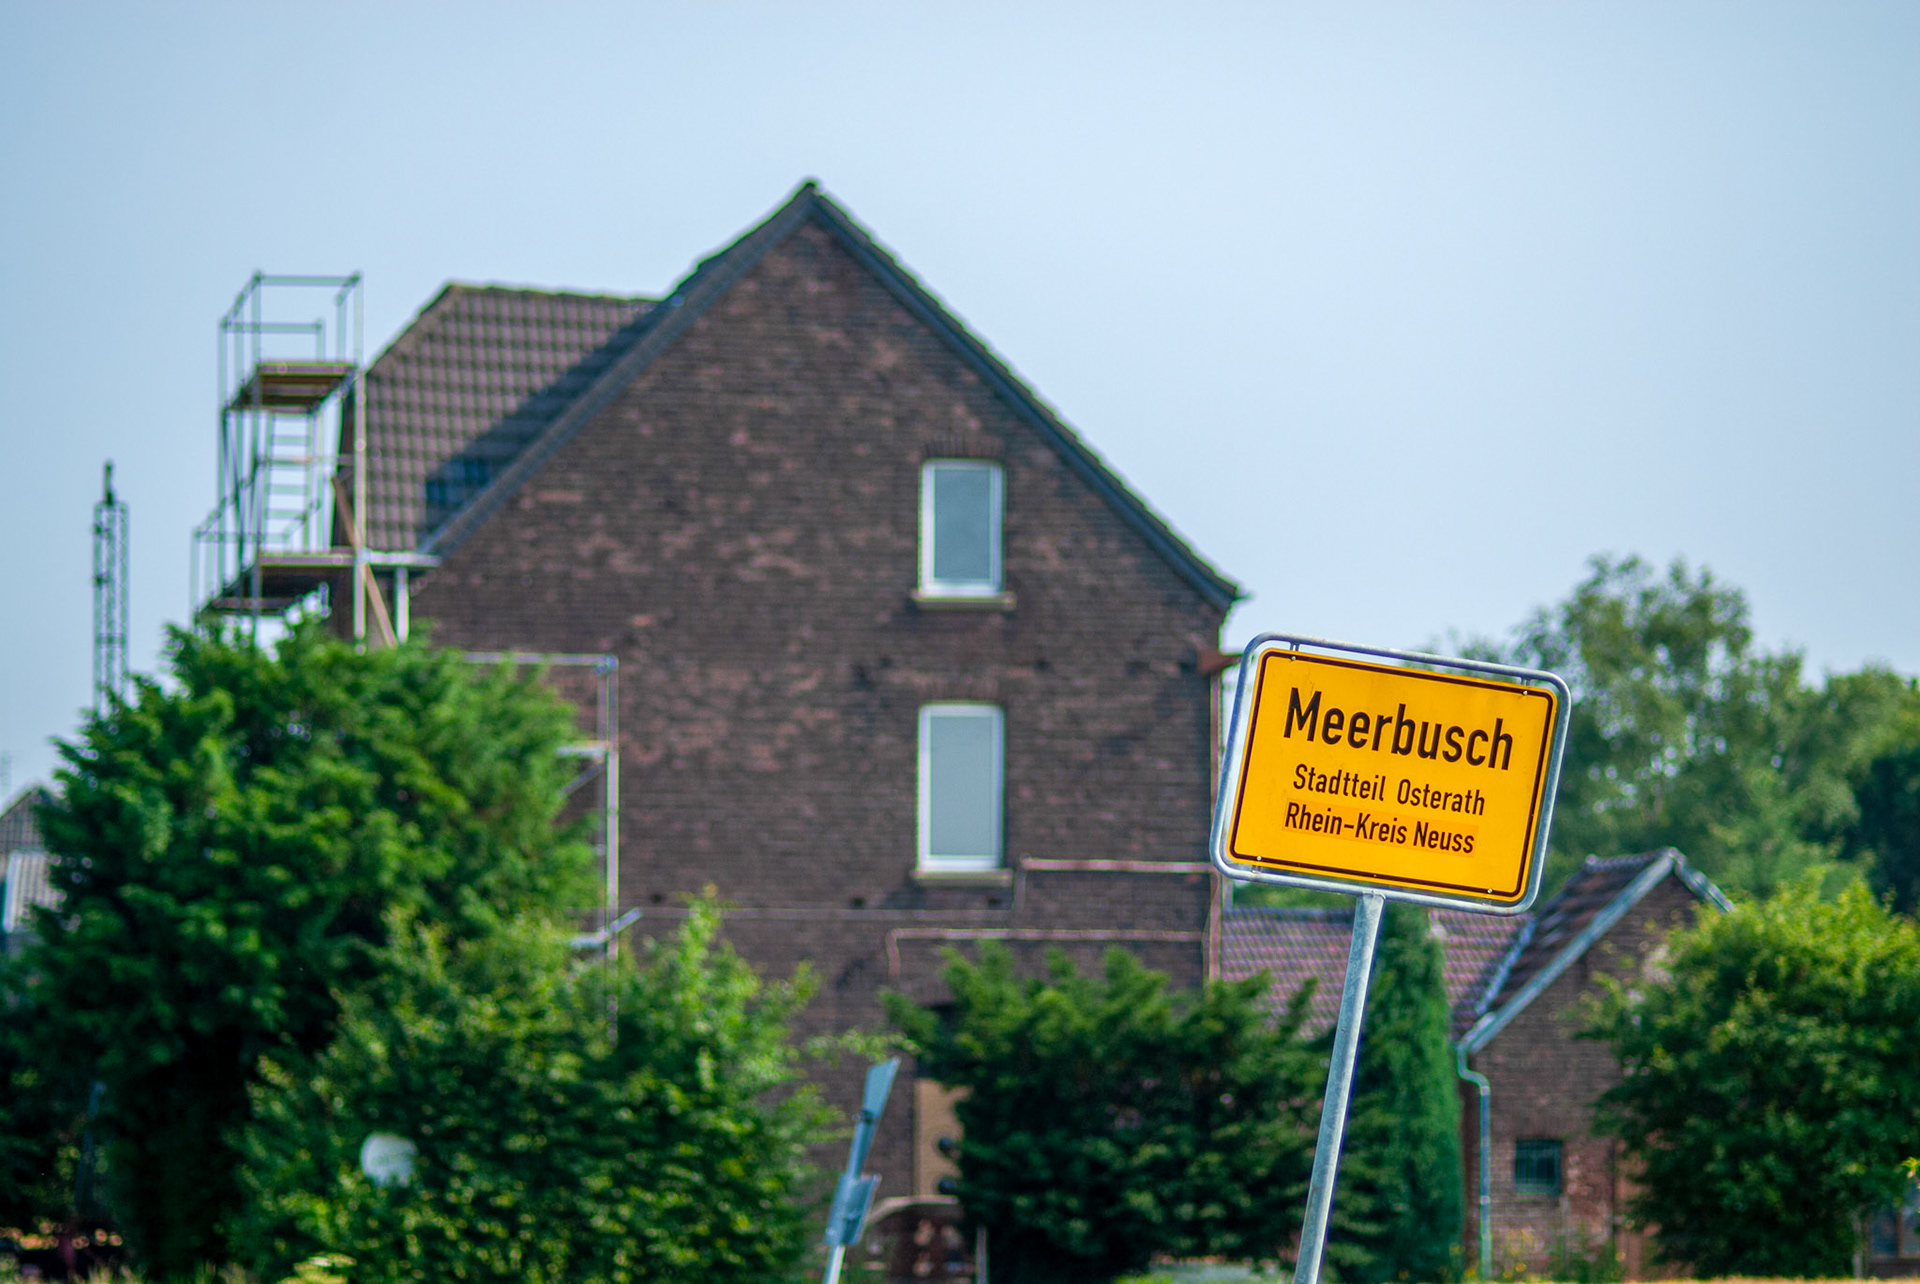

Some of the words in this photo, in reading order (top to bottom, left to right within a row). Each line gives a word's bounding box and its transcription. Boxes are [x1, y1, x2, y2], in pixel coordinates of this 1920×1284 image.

[1283, 687, 1513, 771] Meerbusch
[1293, 764, 1386, 801] Stadtteil
[1397, 779, 1485, 816] Osterath
[1285, 802, 1407, 844] Rhein-Kreis
[1413, 821, 1474, 854] Neuss
